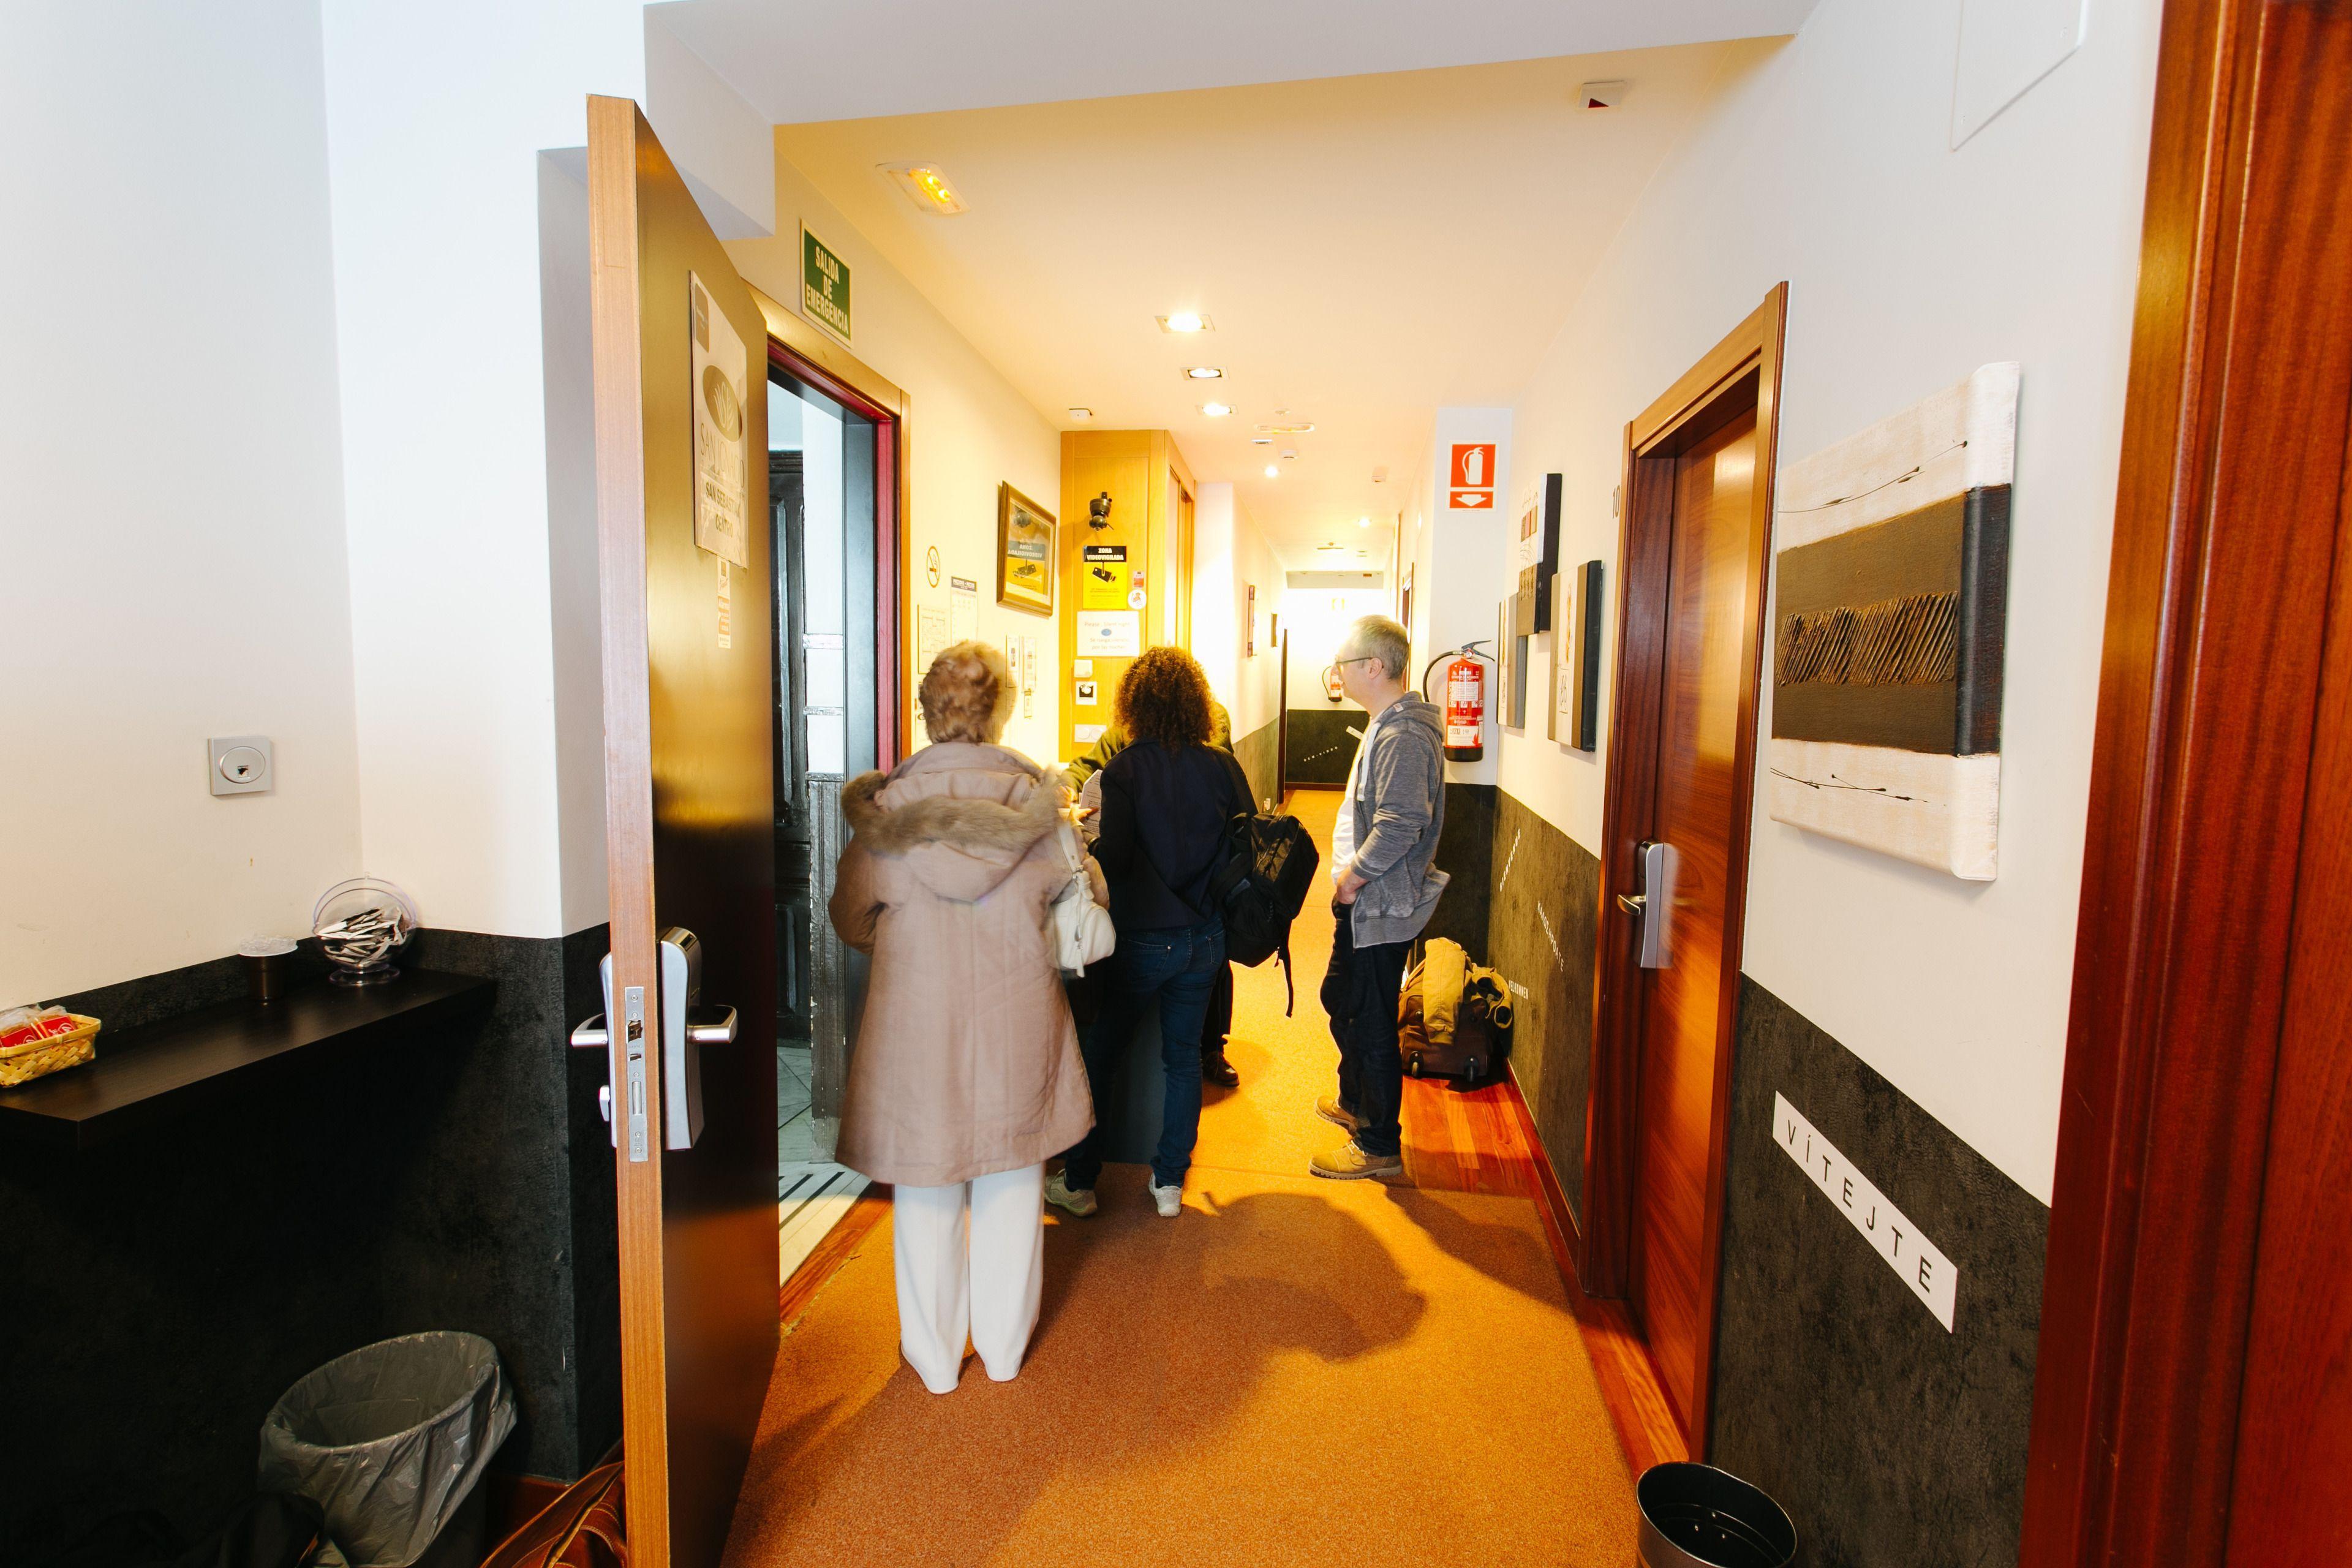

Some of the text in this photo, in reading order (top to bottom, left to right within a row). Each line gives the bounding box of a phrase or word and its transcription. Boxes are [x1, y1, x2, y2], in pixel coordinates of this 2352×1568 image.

[815, 246, 839, 284] SALIDA
[824, 275, 832, 300] DE
[805, 283, 849, 335] EMERGENCIA
[700, 422, 715, 464] SAN
[706, 481, 715, 502] SAN
[715, 513, 733, 538] CENTRO
